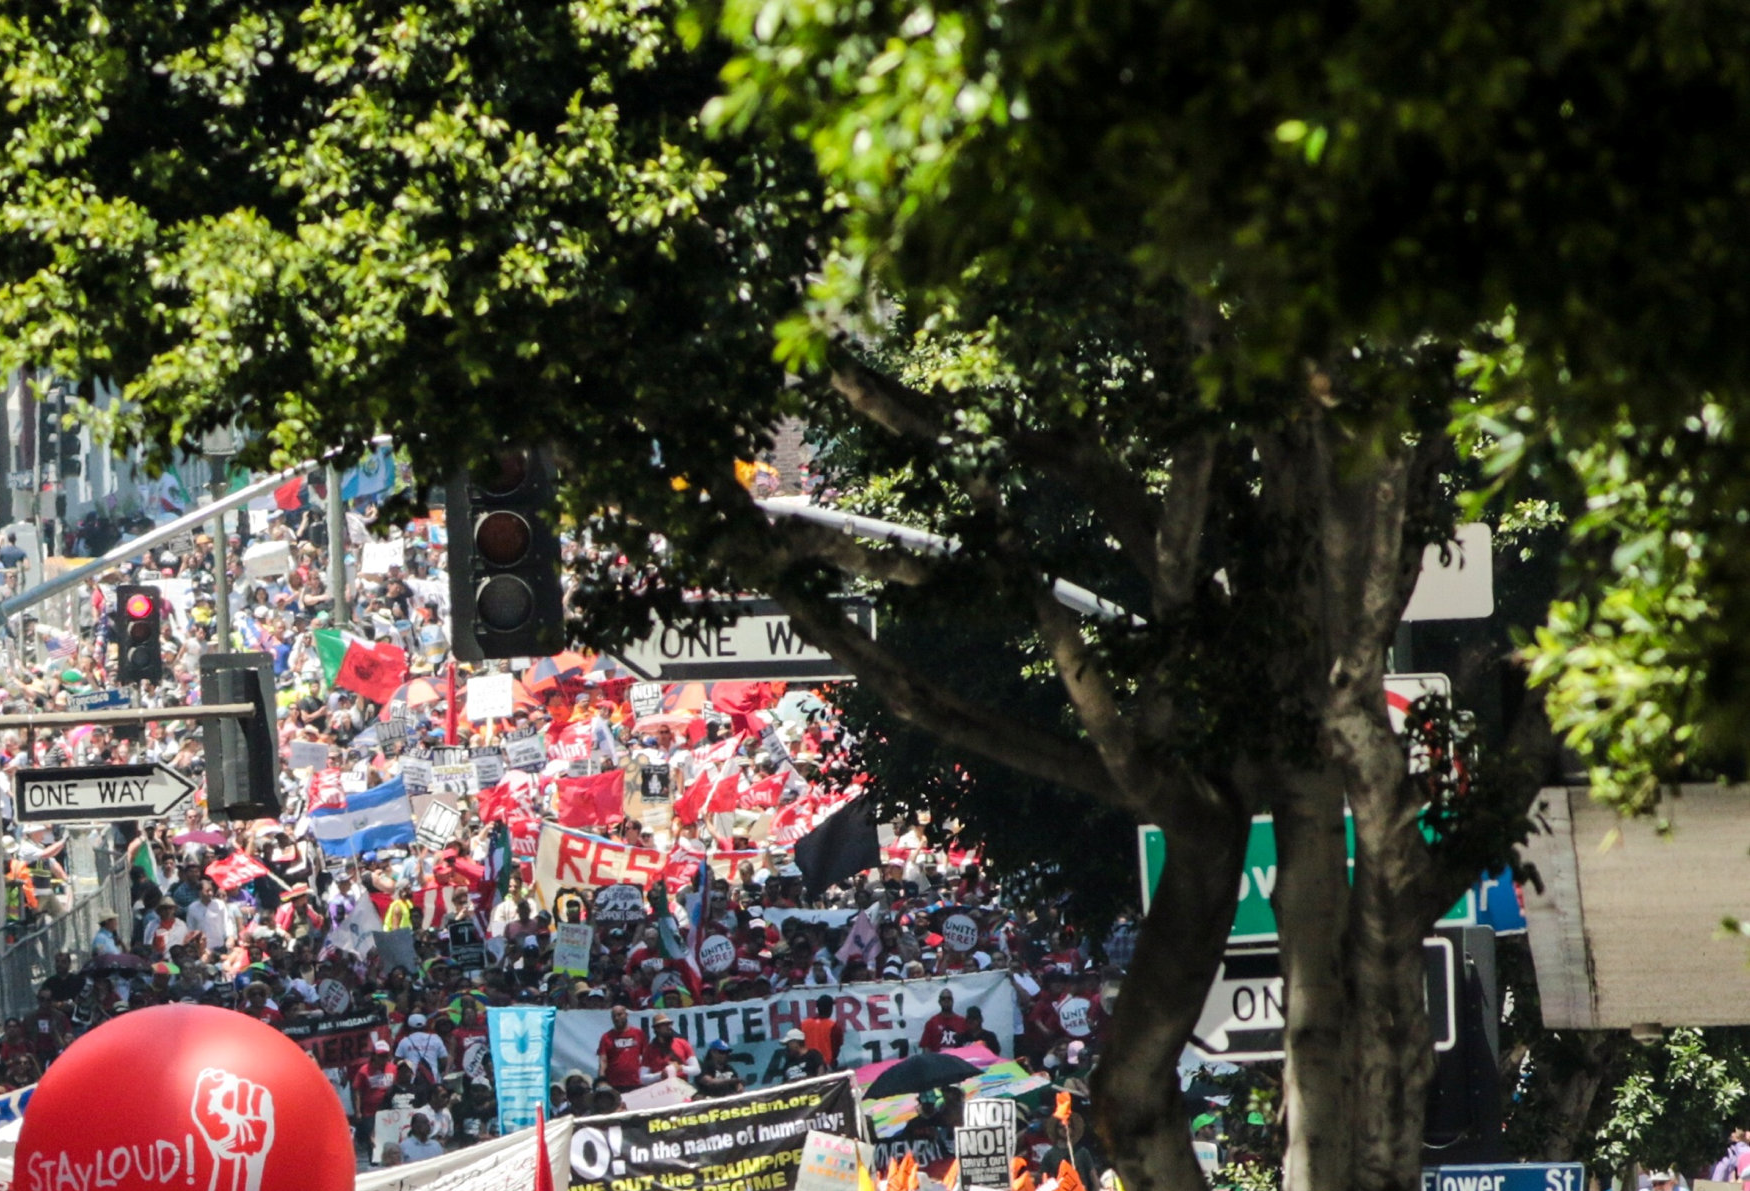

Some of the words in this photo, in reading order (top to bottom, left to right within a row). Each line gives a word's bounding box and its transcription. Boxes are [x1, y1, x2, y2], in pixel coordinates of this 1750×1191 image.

[661, 623, 737, 658] ONE
[29, 783, 79, 807] ONE
[98, 779, 150, 803] WAY
[556, 833, 758, 892] REST
[944, 931, 976, 945] HERE!
[946, 922, 977, 936] UNITE
[701, 941, 732, 957] UNITE
[704, 950, 733, 967] HERE!
[1061, 1007, 1088, 1021] UNIT
[1232, 985, 1285, 1021] ON
[648, 1094, 822, 1134] RefuseFascism.org
[968, 1101, 1014, 1127] NO!
[569, 1125, 626, 1181] O!
[630, 1146, 649, 1164] In
[652, 1141, 682, 1160] the
[684, 1135, 734, 1157] name
[736, 1127, 755, 1145] of
[758, 1111, 845, 1142] humanity:
[960, 1129, 1004, 1156] NO!
[95, 1133, 195, 1188] LOUD!
[661, 1169, 694, 1187] the
[700, 1148, 801, 1183] TRUMP/PE
[961, 1158, 986, 1168] DRIVE
[988, 1156, 1006, 1166] OUT
